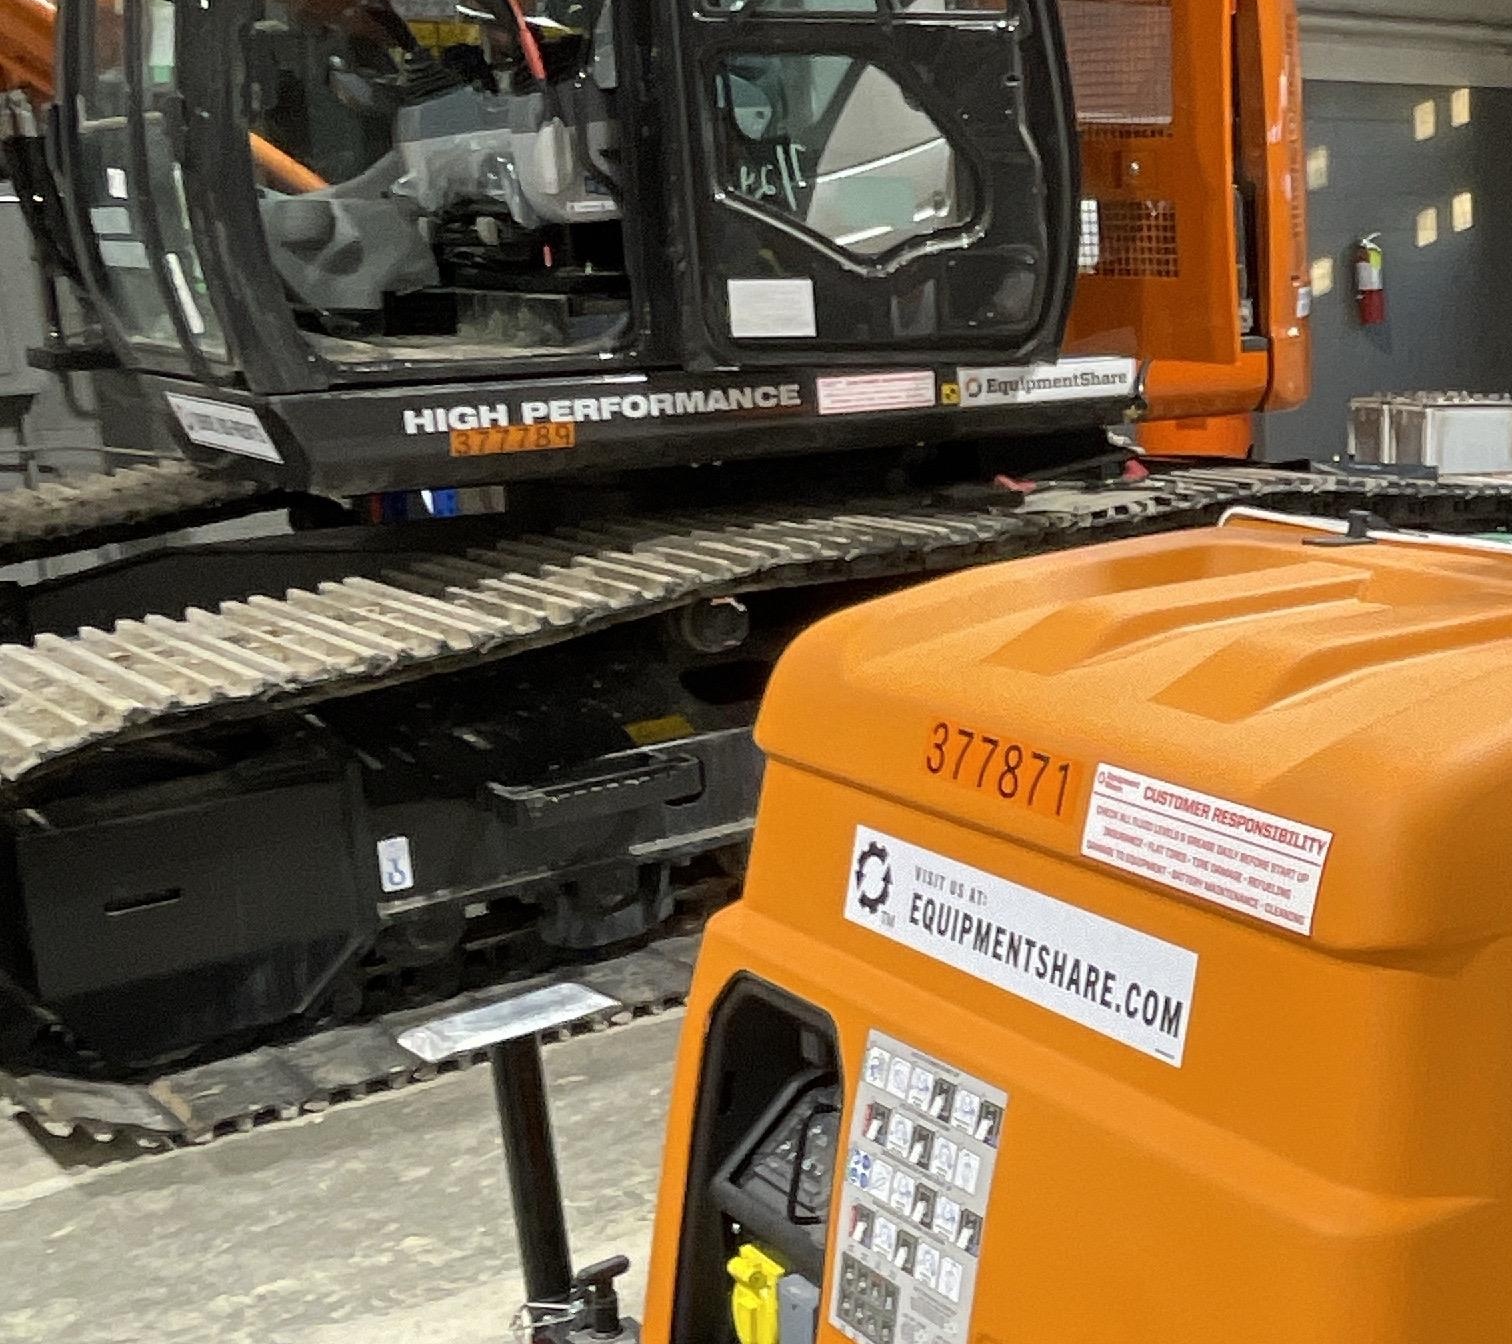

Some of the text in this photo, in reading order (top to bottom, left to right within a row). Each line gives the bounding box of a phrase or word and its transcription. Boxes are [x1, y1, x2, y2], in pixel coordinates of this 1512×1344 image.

[402, 402, 511, 435] HIGH
[521, 382, 802, 427] PERFORMANCE
[986, 370, 1128, 396] EquipmentShare
[453, 422, 573, 455] 377789
[926, 721, 1070, 817] 377871
[1143, 786, 1326, 856] CUSTOMER RESPONSIBILITY
[914, 864, 989, 907] VISIT US AT:
[908, 891, 1185, 1039] EQUIPMENTSHARE.COM
